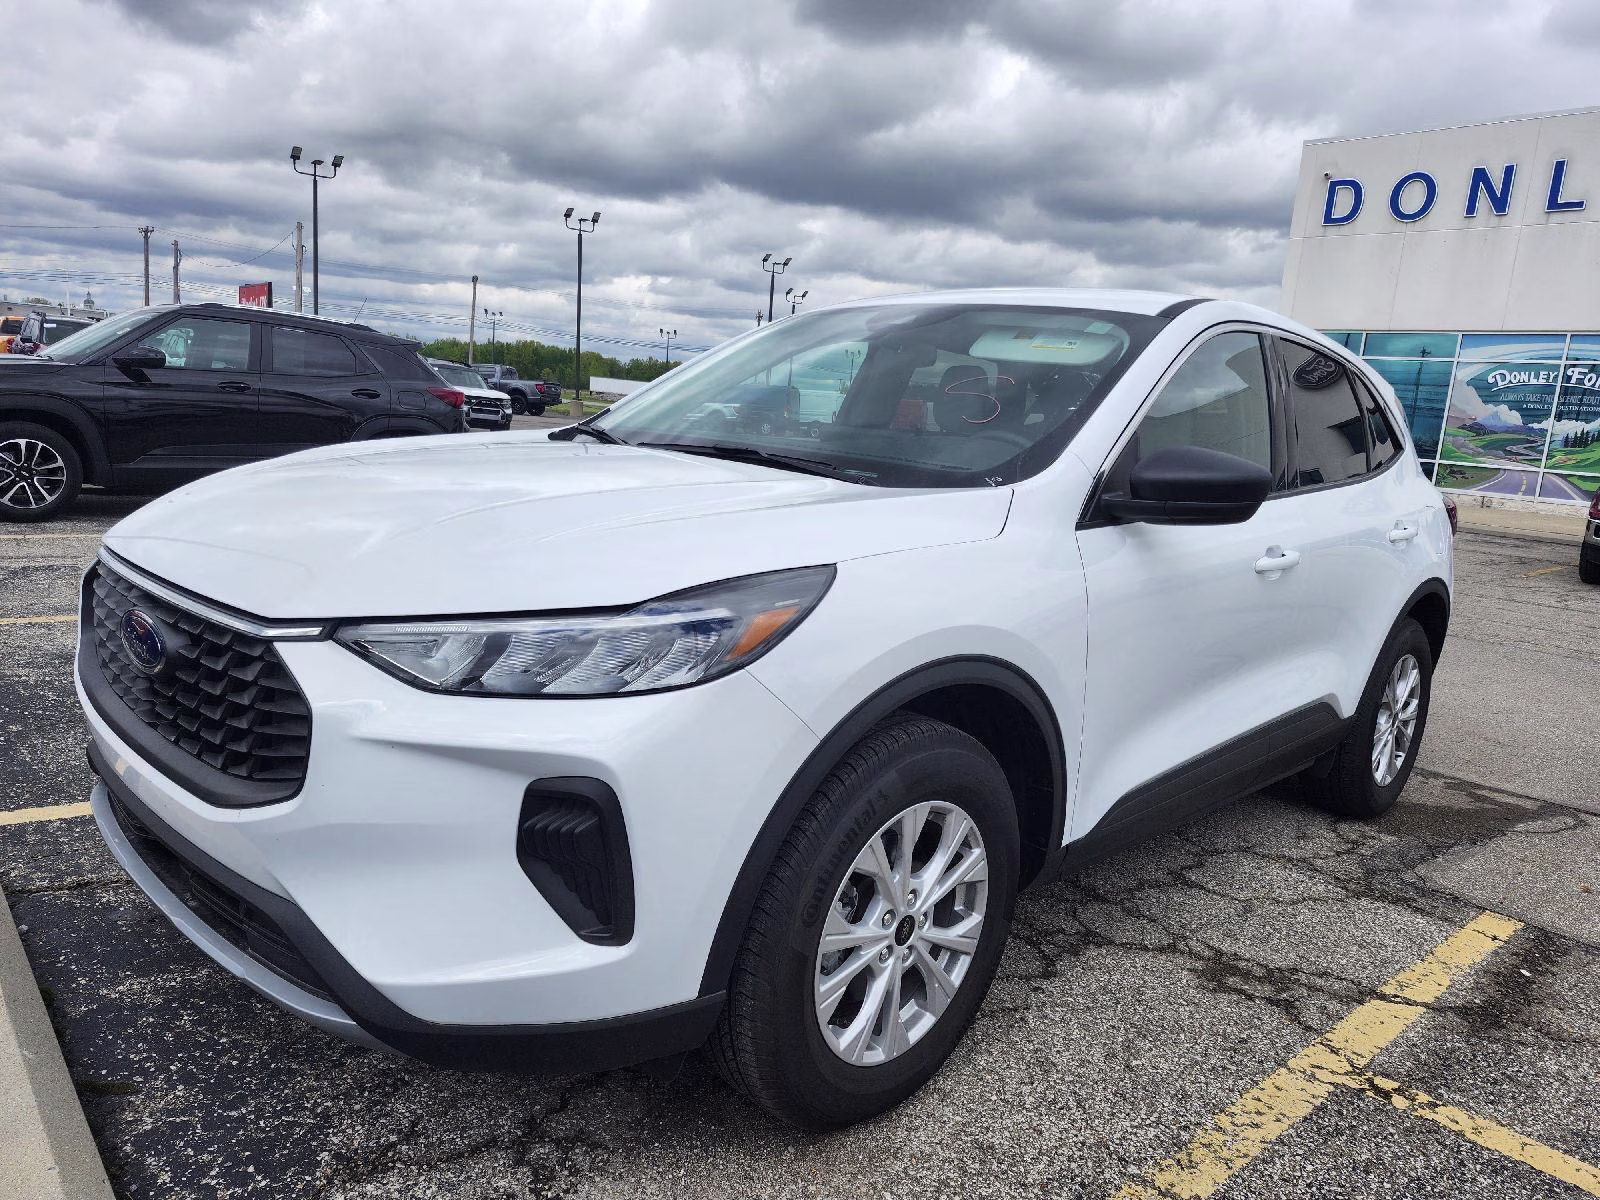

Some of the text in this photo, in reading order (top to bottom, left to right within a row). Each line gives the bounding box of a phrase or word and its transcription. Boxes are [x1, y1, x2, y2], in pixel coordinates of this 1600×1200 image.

[1321, 159, 1587, 226] DONL
[1487, 369, 1559, 386] DONLEY
[1525, 393, 1541, 402] TAKE
